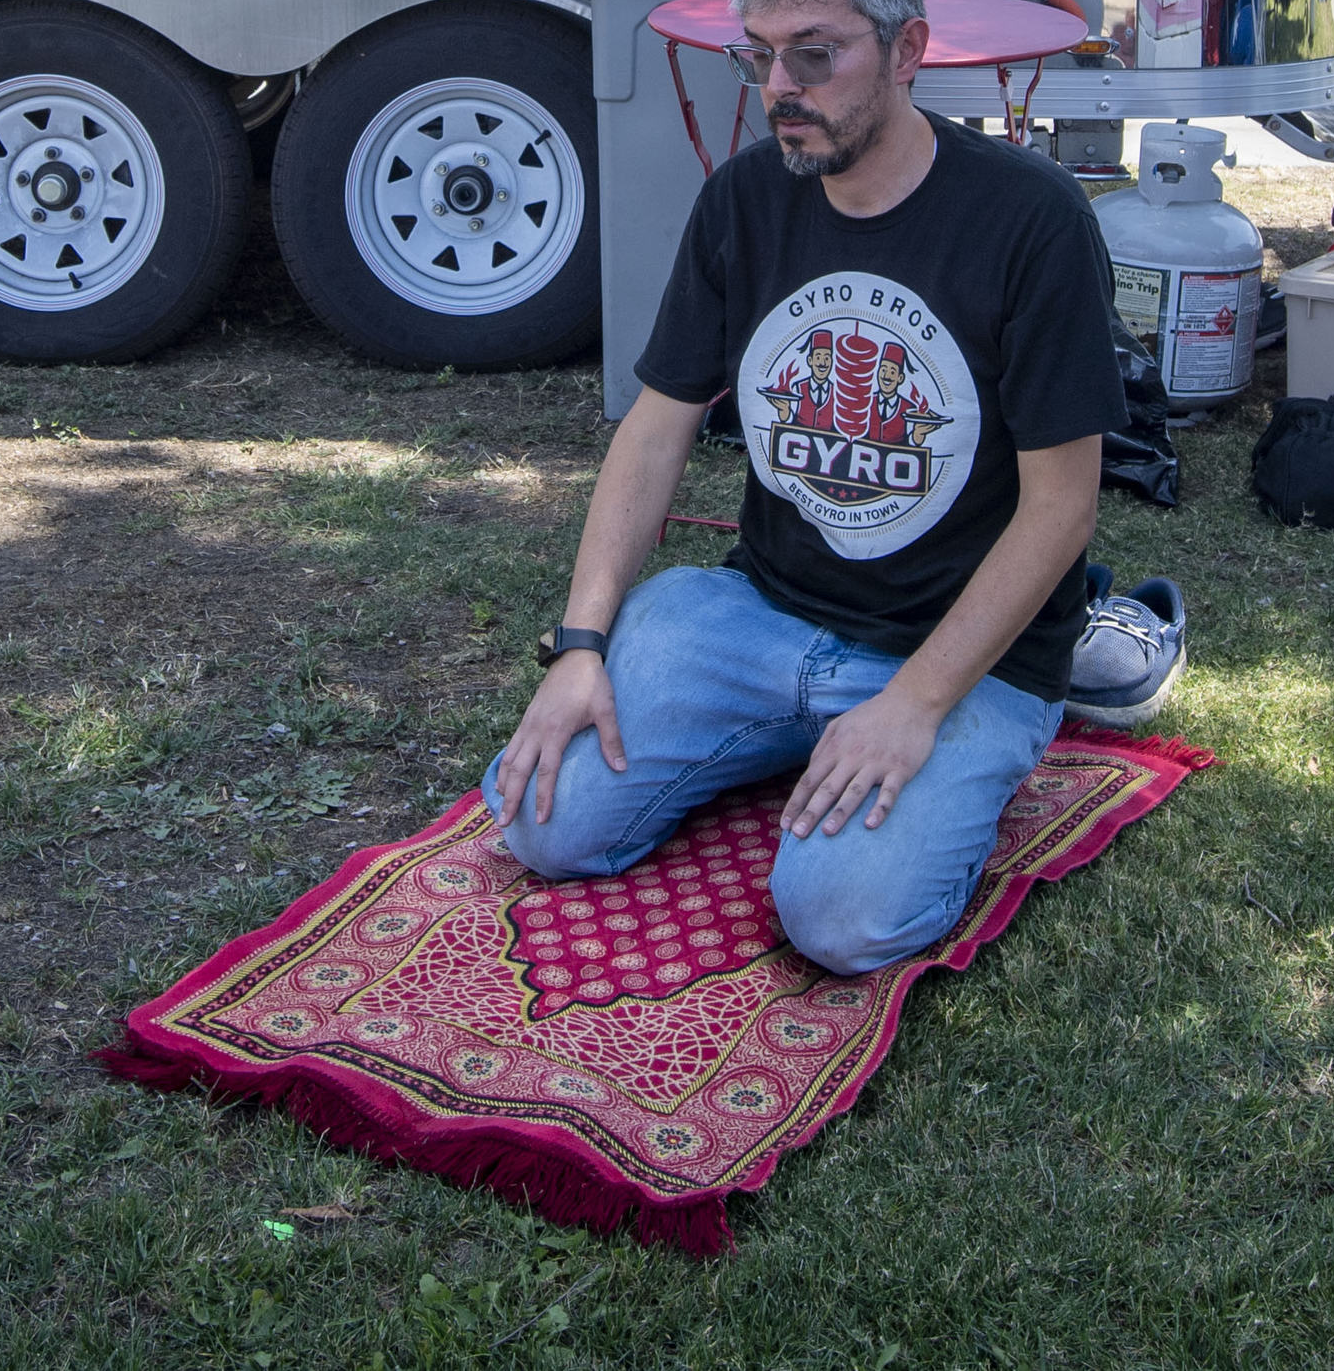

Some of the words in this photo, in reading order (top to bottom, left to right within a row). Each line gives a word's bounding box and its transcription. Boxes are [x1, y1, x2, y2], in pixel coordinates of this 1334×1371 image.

[789, 284, 852, 318] GYRO
[870, 288, 937, 342] BROS
[1136, 281, 1159, 296] Trip
[777, 431, 920, 489] GYRO
[787, 482, 814, 512] BEST
[814, 501, 847, 523] GYRO
[849, 510, 862, 523] IN
[865, 500, 901, 523] TOWN
